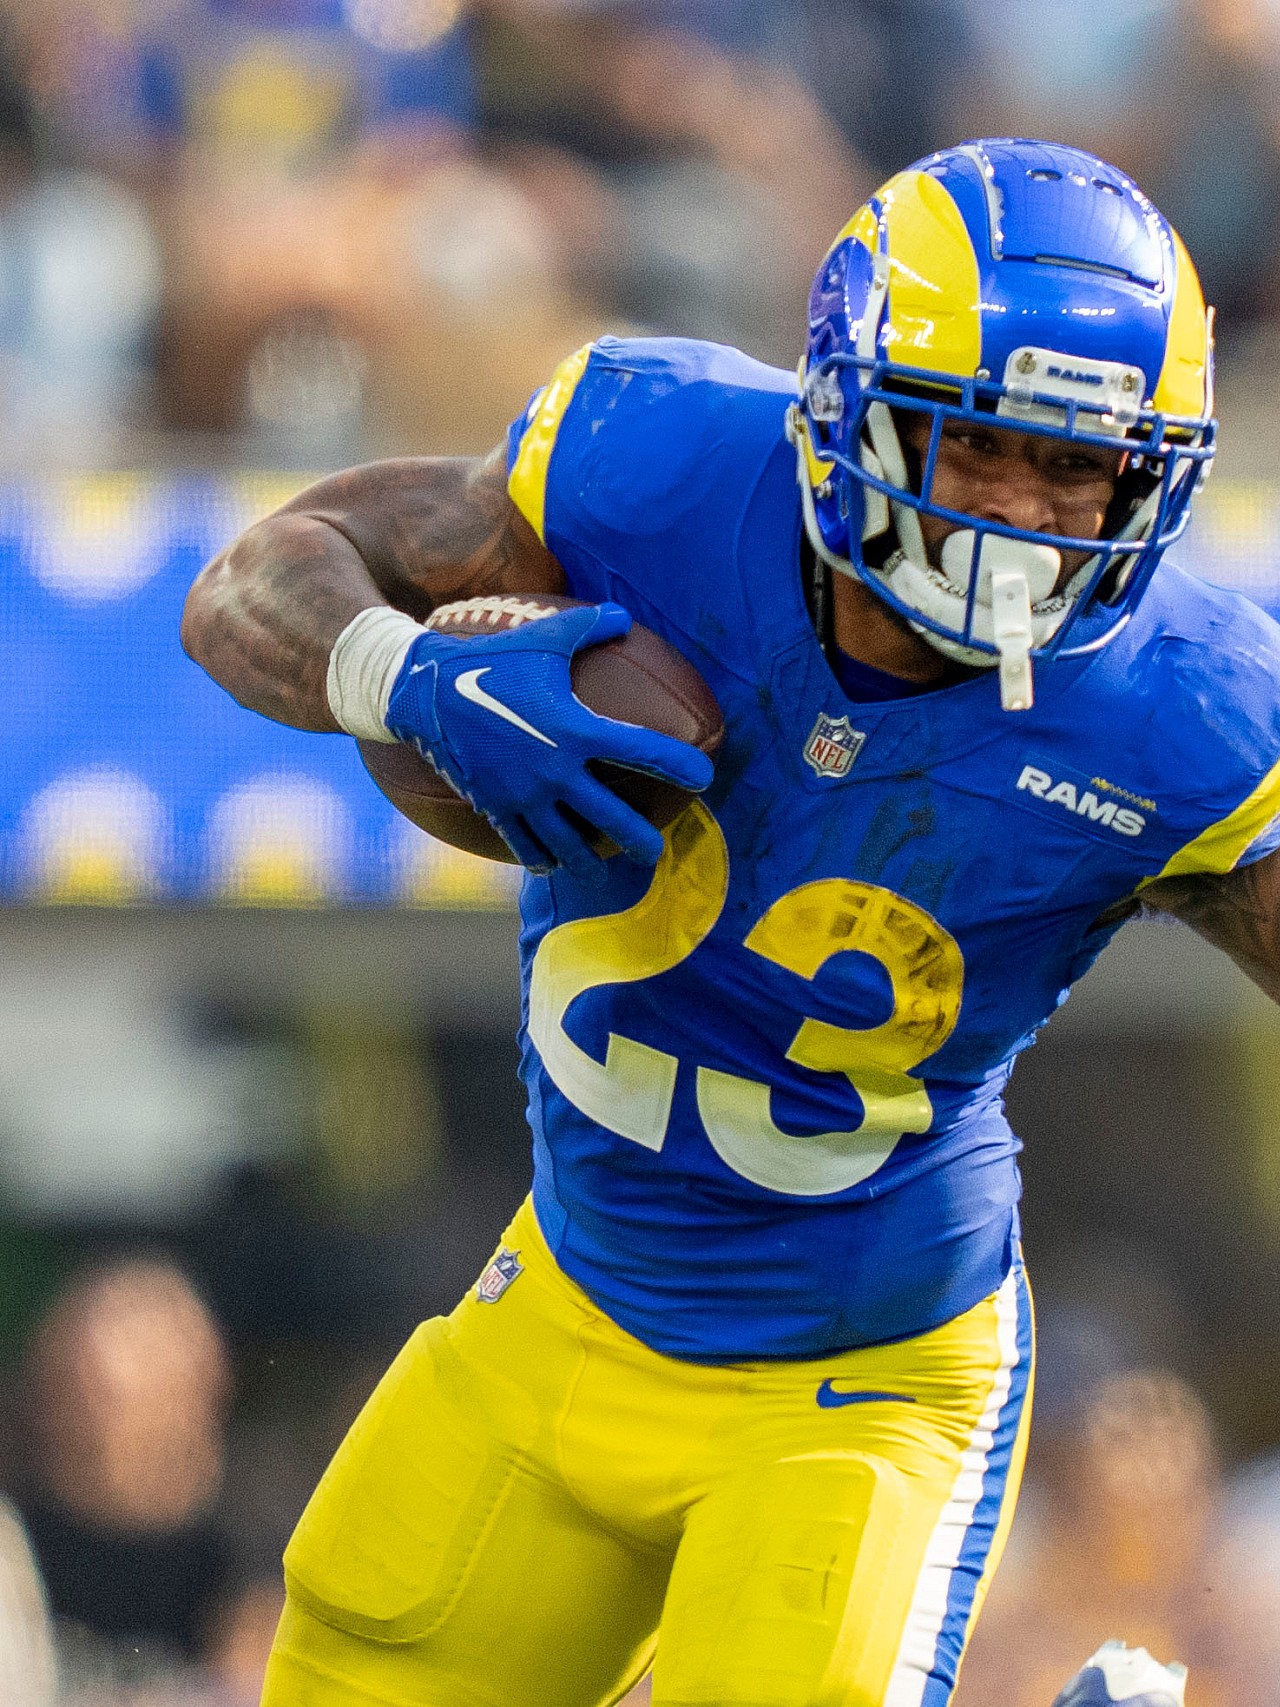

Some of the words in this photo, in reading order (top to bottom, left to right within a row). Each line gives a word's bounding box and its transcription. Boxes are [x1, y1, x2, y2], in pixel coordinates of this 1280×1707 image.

[1046, 365, 1104, 385] RAMS
[810, 738, 847, 769] NFL
[1016, 764, 1146, 837] RAMS
[527, 799, 965, 1196] 23
[481, 1269, 504, 1296] NFL
